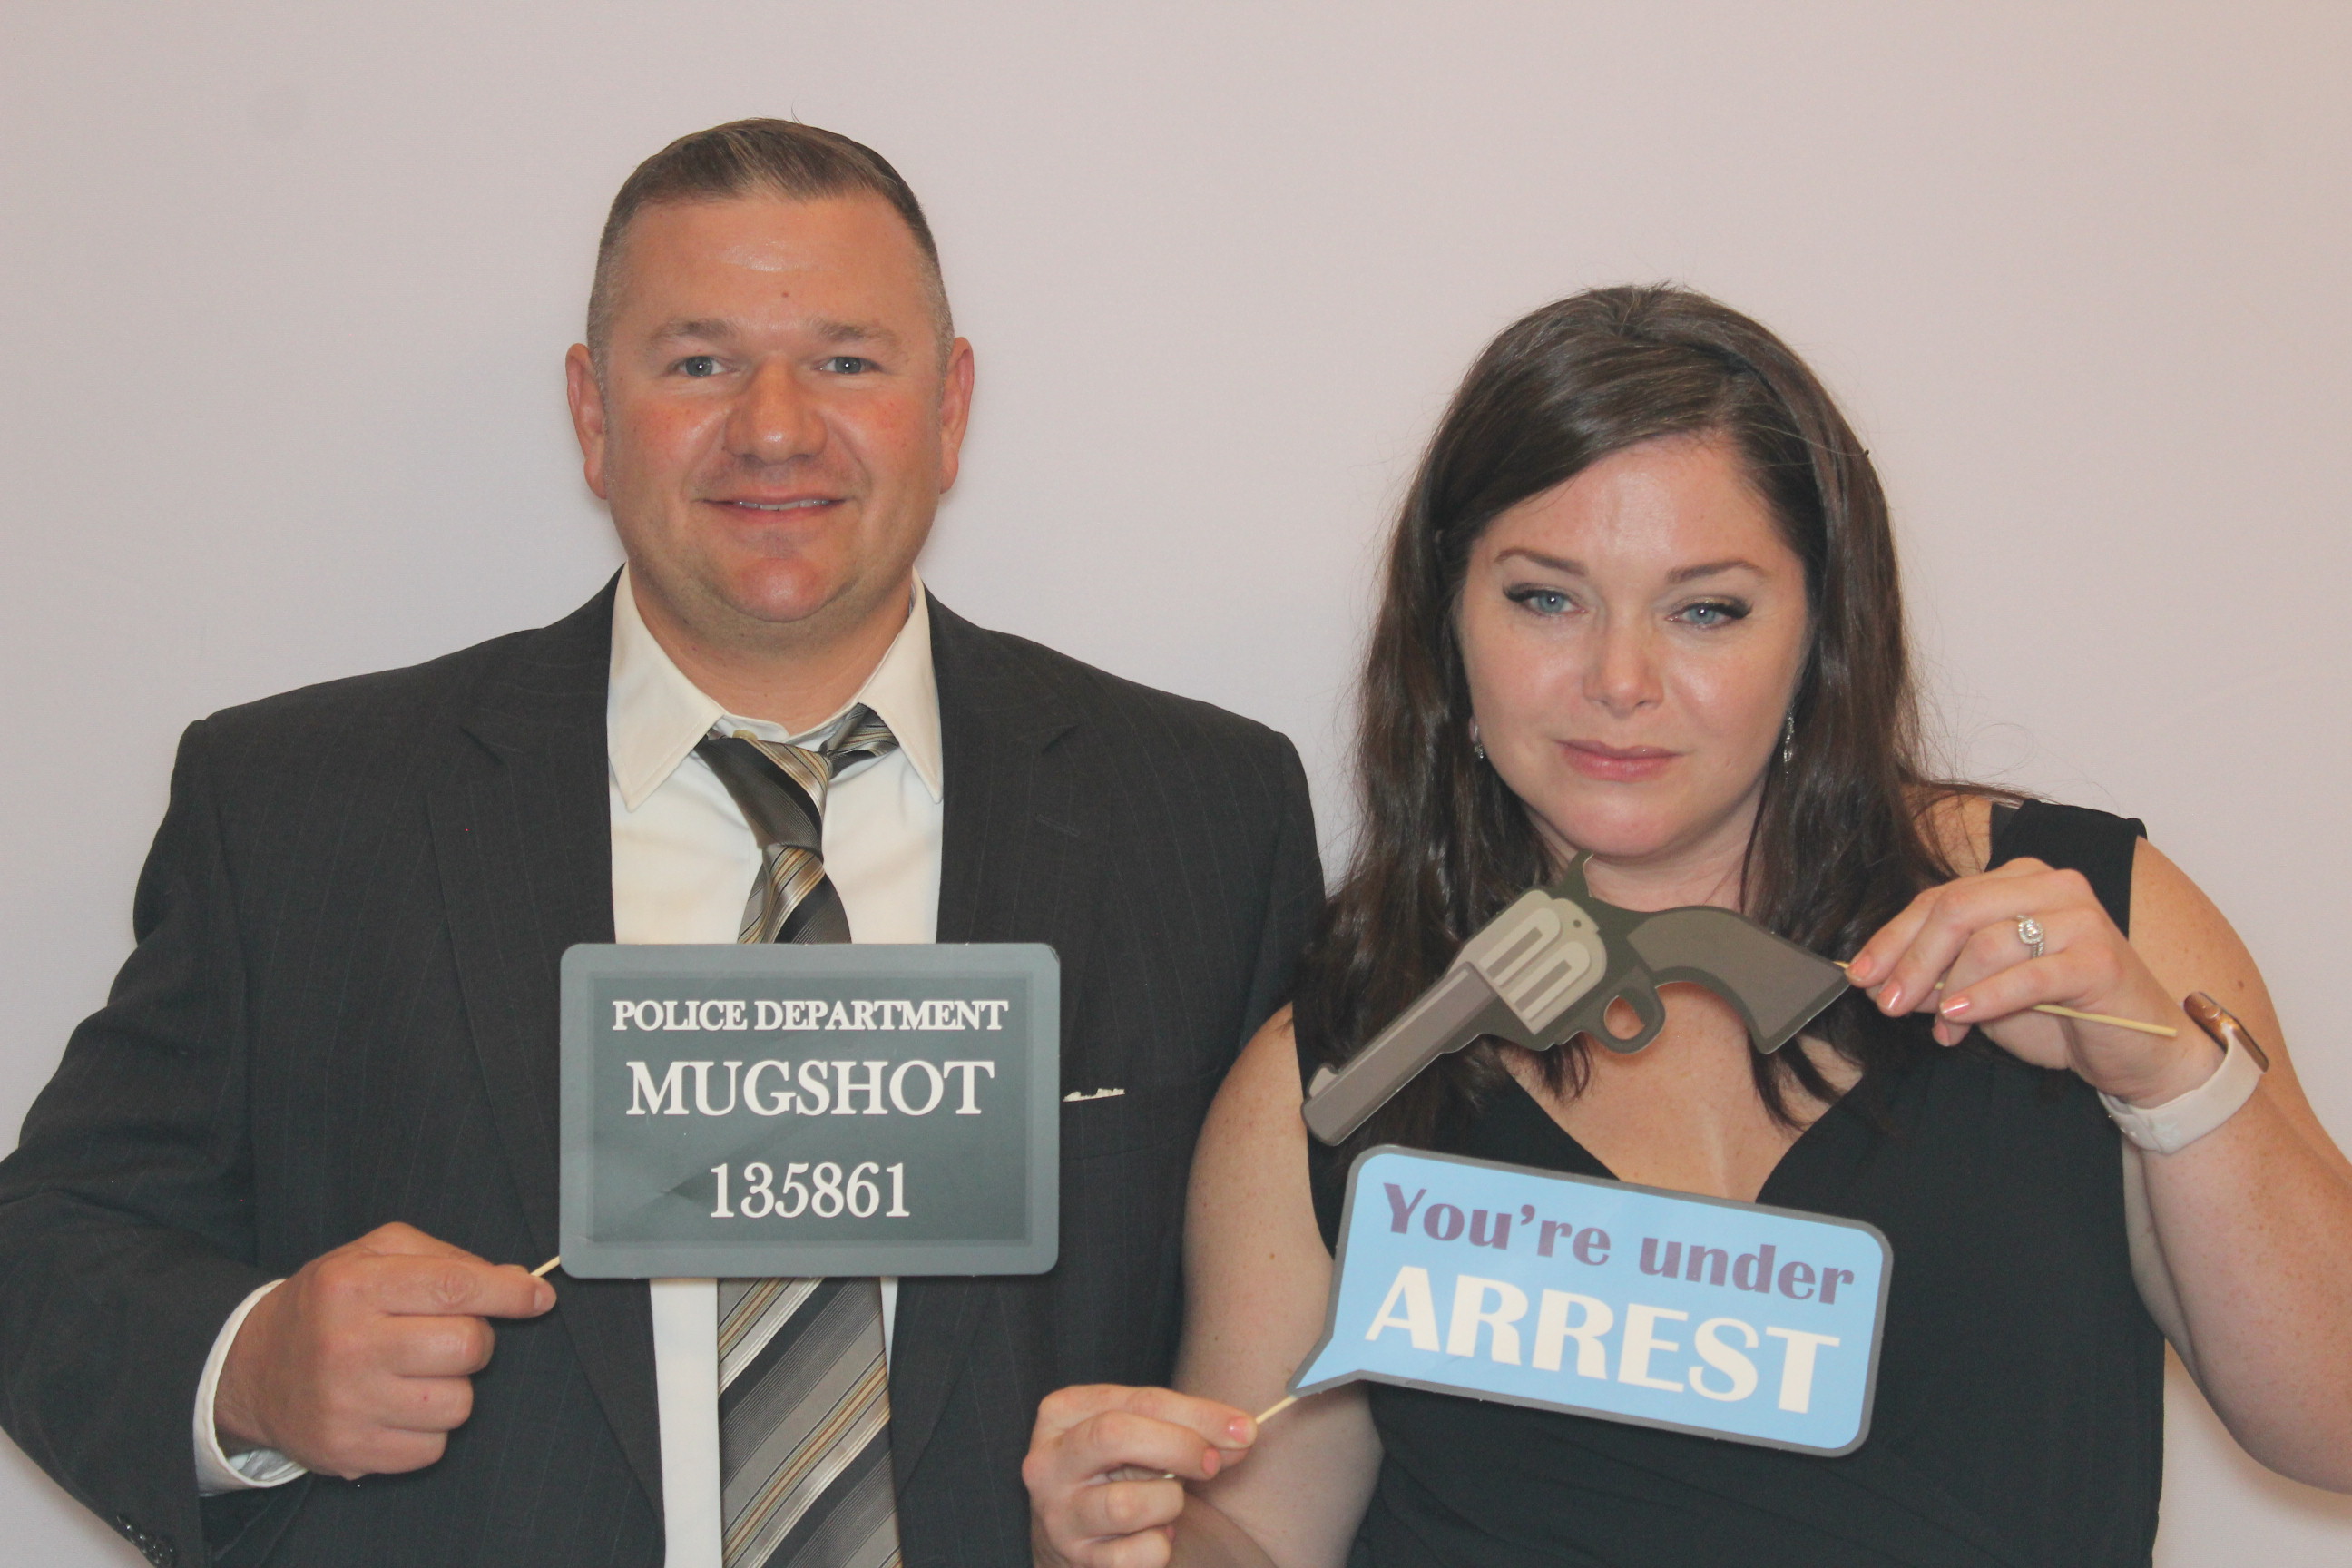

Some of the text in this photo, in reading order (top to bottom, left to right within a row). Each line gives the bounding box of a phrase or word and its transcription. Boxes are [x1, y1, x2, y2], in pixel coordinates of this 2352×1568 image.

[612, 1000, 1009, 1031] POLICE DEPARTMENT
[625, 1060, 995, 1116] MUGSHOT
[710, 1162, 910, 1219] 135861
[1383, 1182, 1854, 1305] You're under
[1365, 1266, 1841, 1414] ARREST
